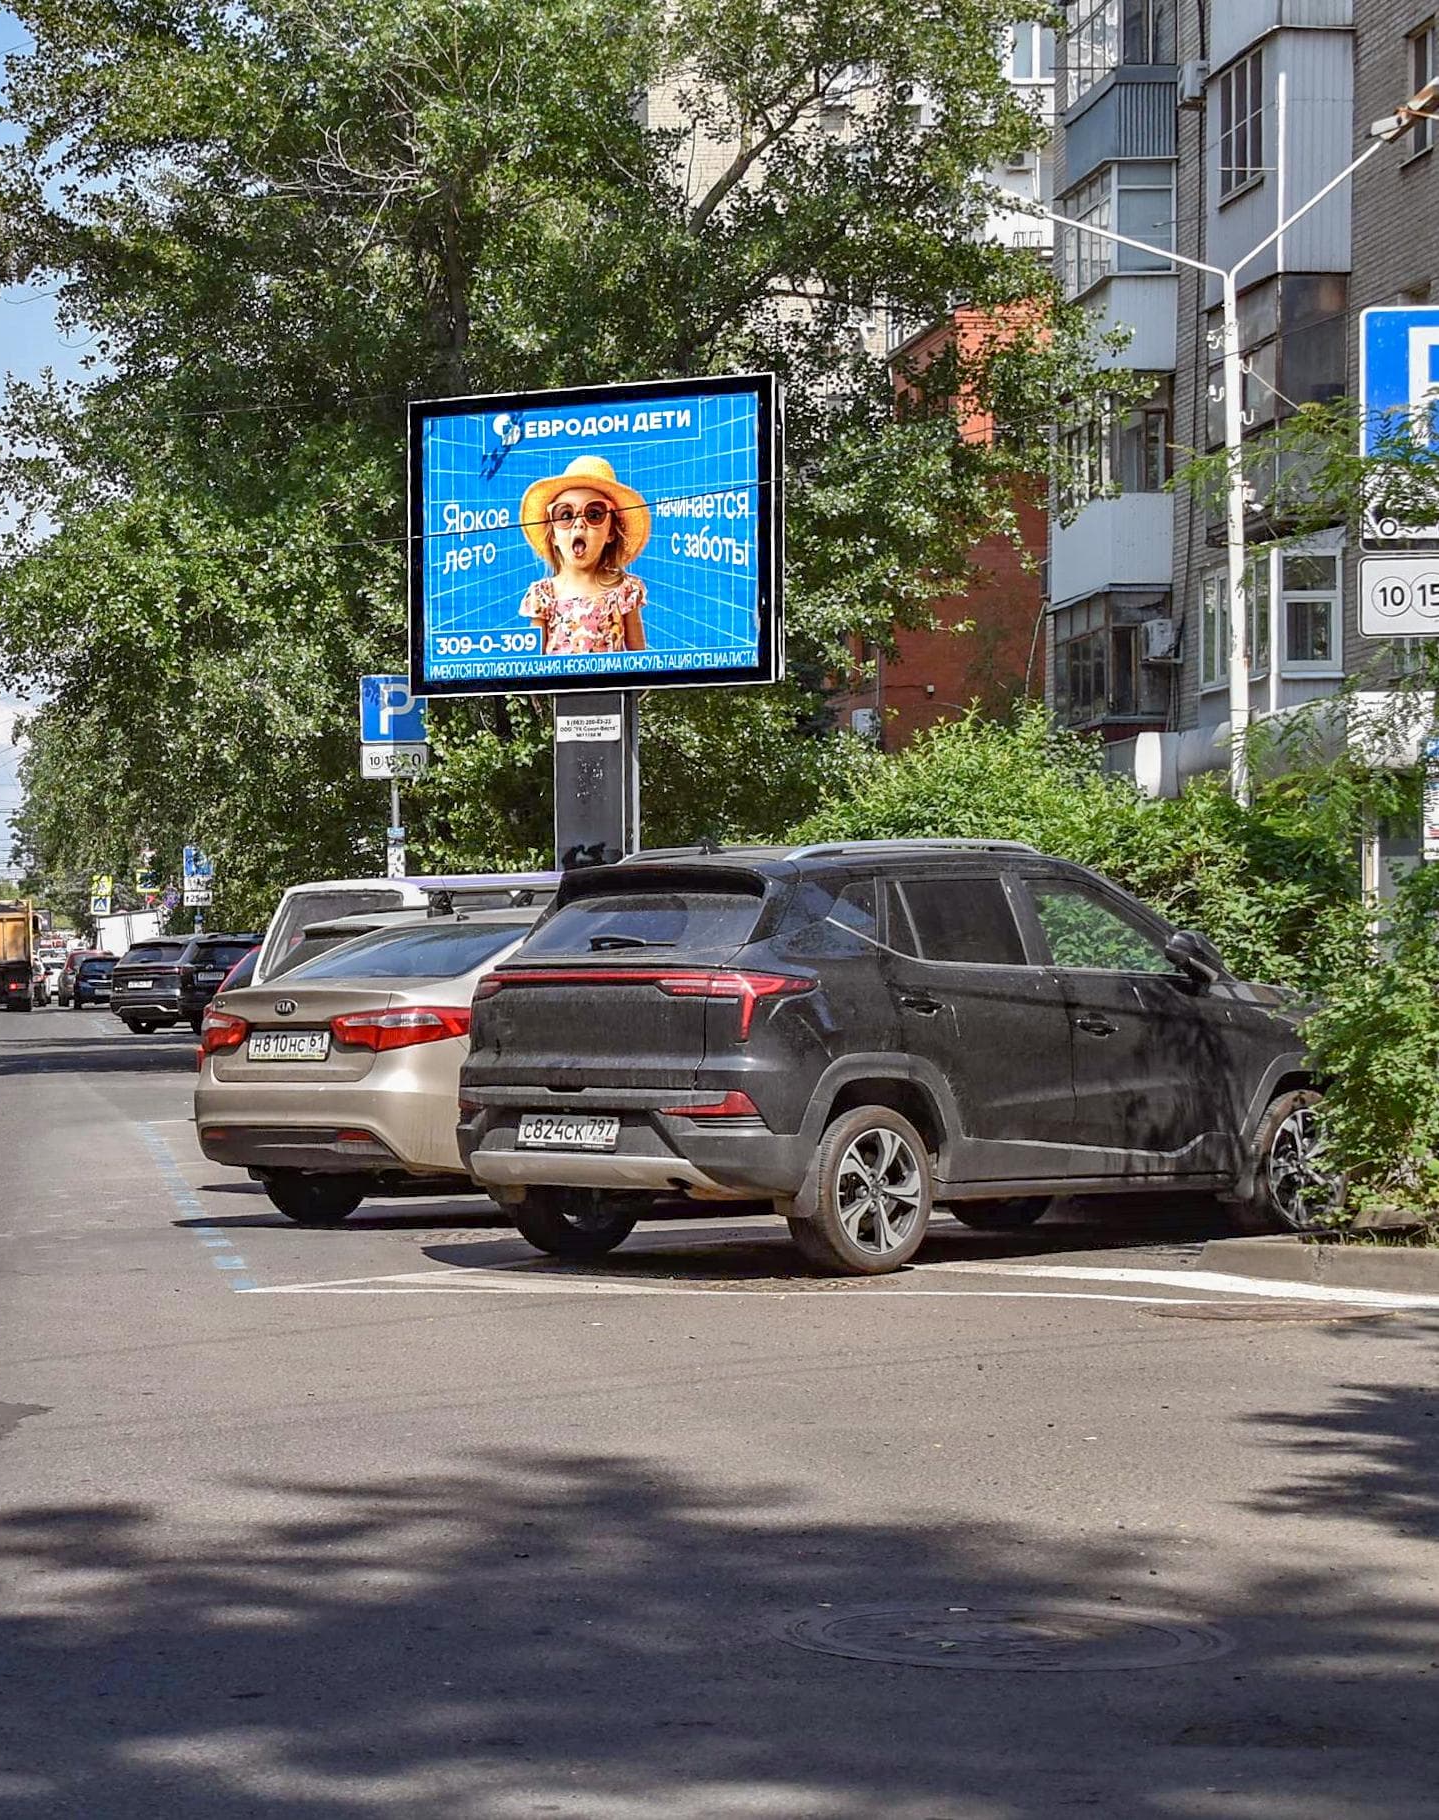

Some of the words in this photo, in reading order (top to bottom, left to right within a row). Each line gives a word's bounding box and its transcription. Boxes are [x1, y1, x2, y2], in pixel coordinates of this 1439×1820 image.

[525, 414, 629, 438] ЕВРОДОН
[632, 409, 691, 433] ДЕТИ
[656, 491, 749, 519] начинается
[443, 503, 510, 541] Яркое
[442, 543, 496, 575] лето
[671, 532, 680, 555] с
[683, 525, 749, 567] заботы
[1378, 586, 1404, 607] 10
[1417, 584, 1439, 607] 15
[435, 633, 537, 655] 309-0-309
[429, 662, 472, 679] ИМЕЮТСЯ
[563, 655, 622, 674] НЕОБХОДИМА
[623, 653, 692, 671] КОНСУЛЬТАЦИЯ
[692, 650, 756, 668] СПЕЦИАЛИСТА
[379, 684, 416, 735] P
[369, 756, 380, 766] 10
[276, 1001, 293, 1012] KIA
[589, 1119, 614, 1136] 797
